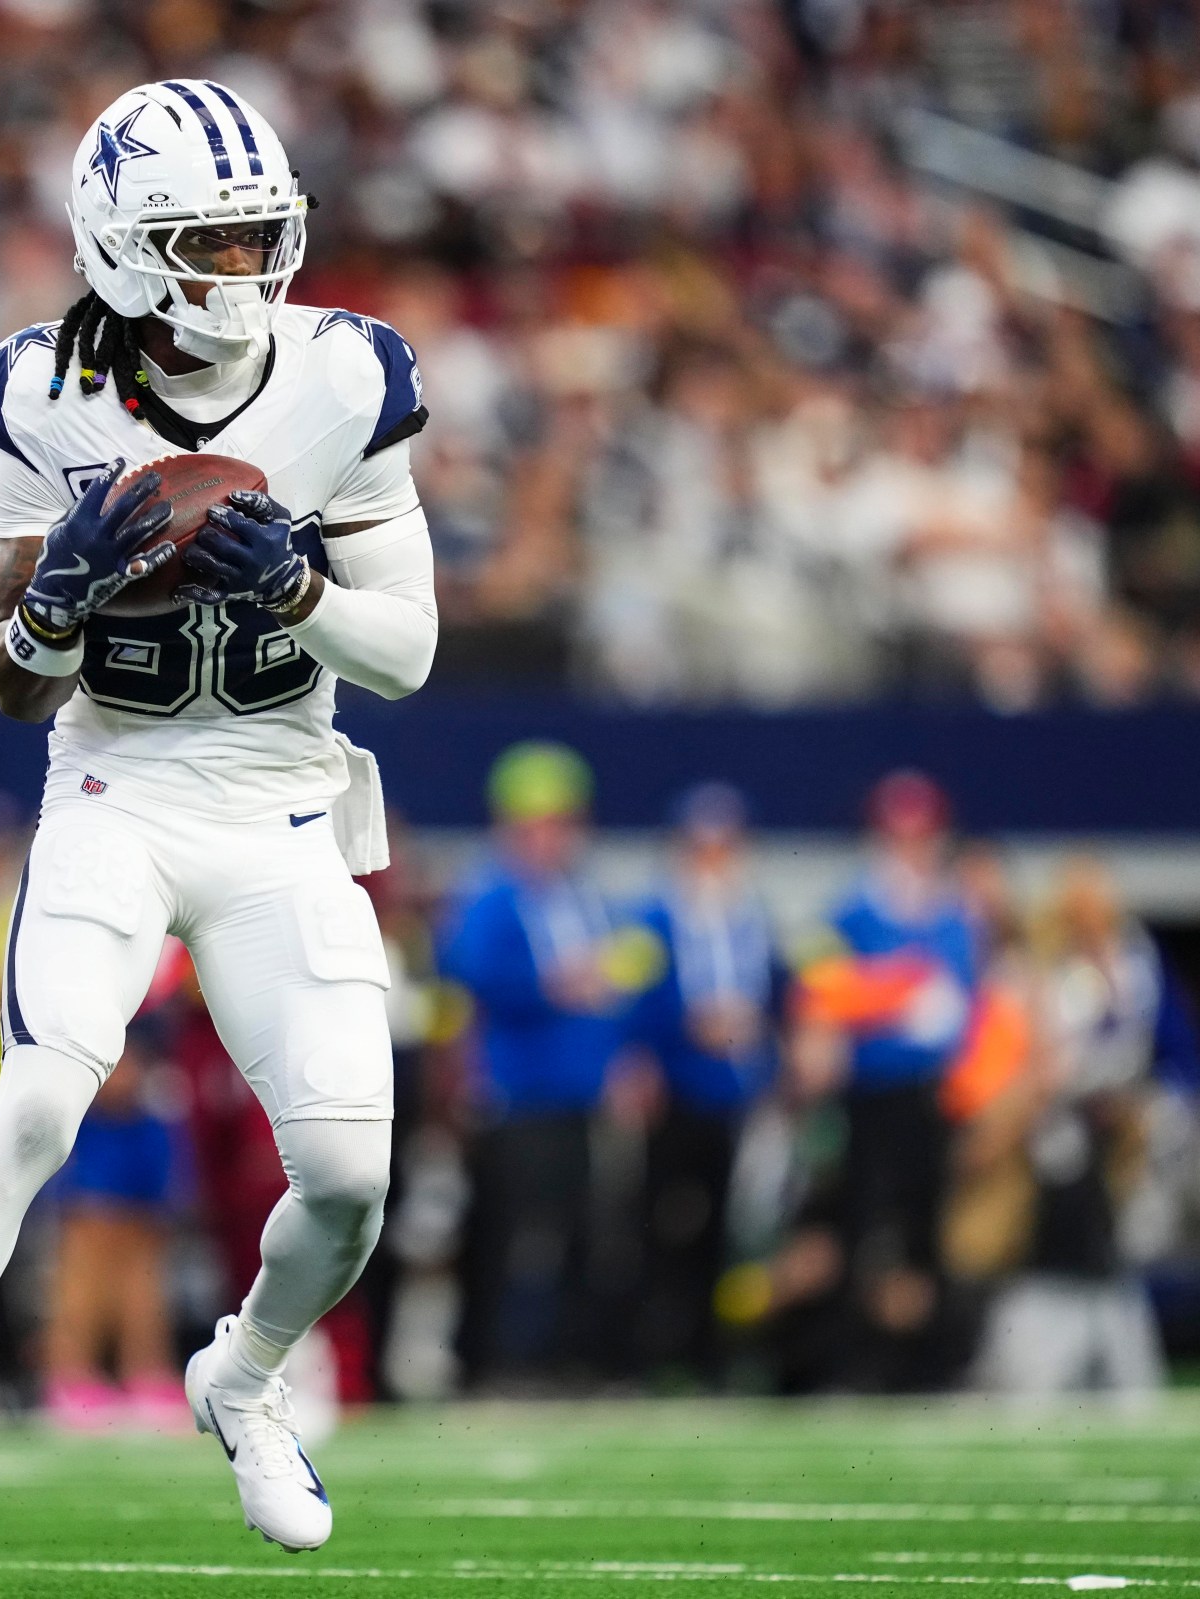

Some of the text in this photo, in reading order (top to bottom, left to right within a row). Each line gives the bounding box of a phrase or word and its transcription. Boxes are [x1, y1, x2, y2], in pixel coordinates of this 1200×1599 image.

[232, 183, 259, 192] COWBOYS
[9, 620, 37, 661] 88
[84, 780, 102, 793] NFL
